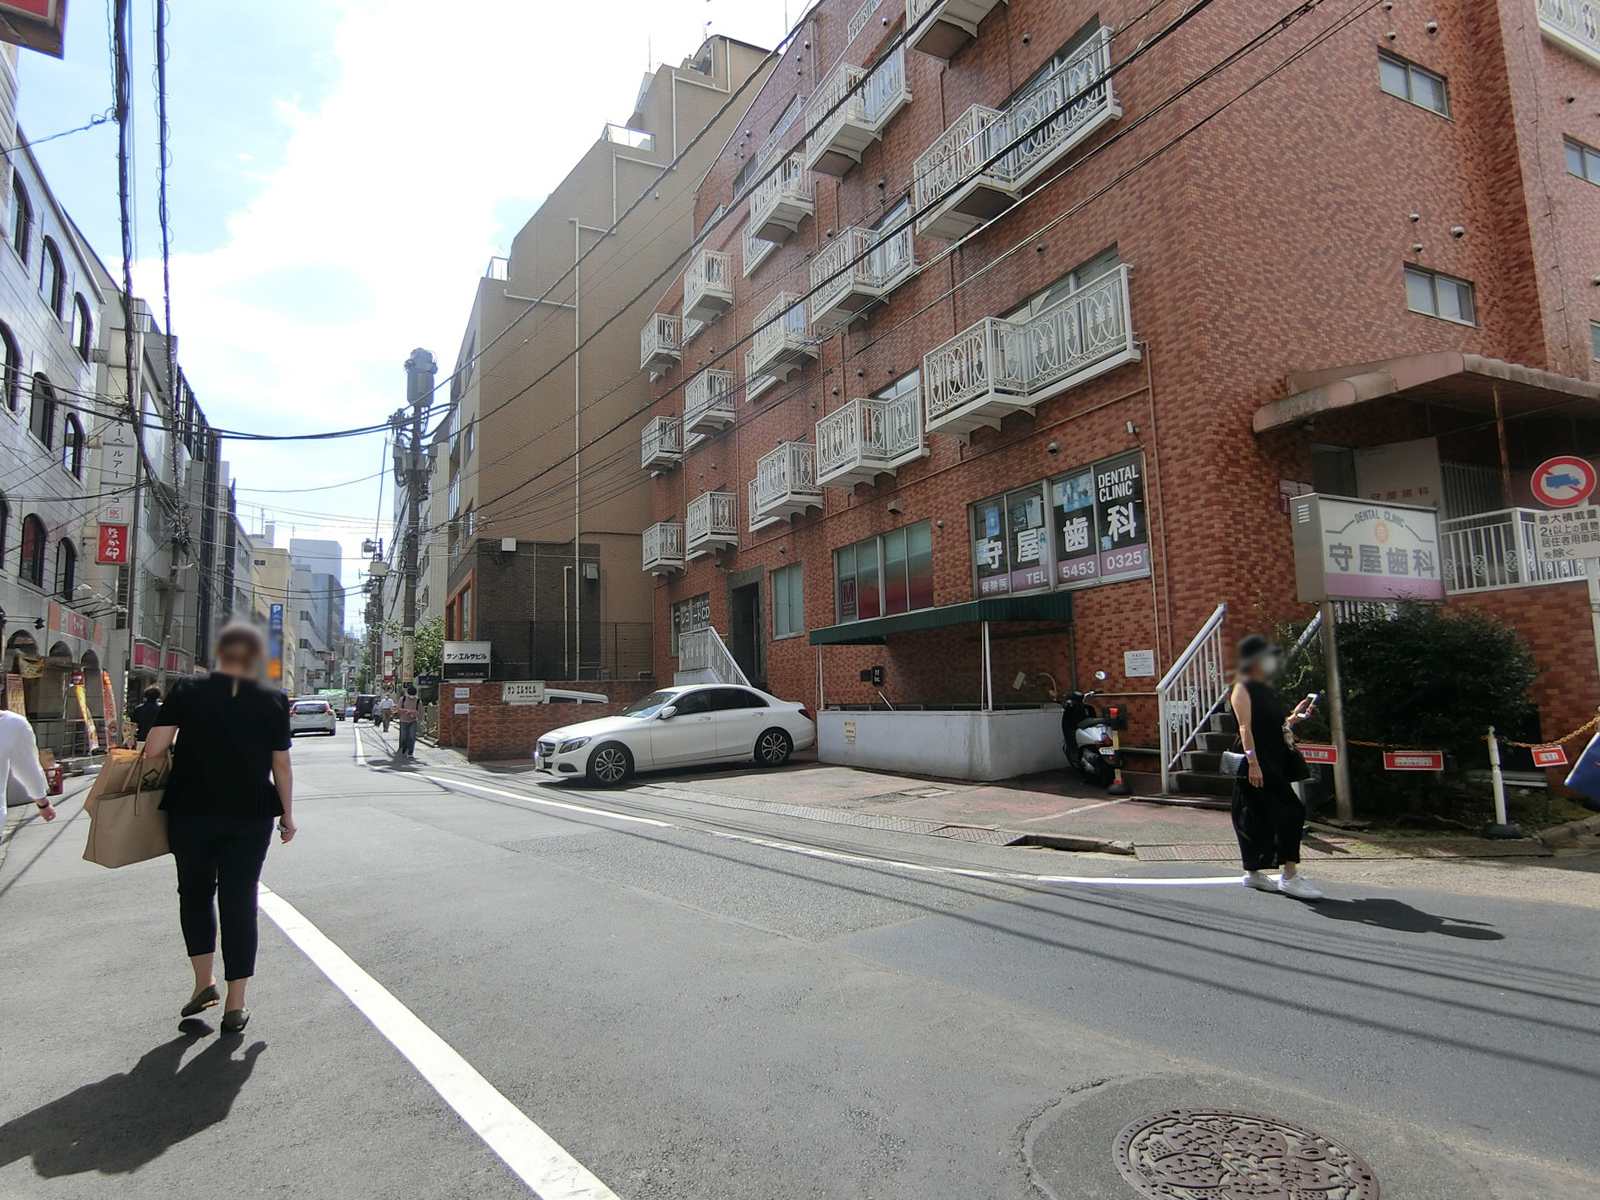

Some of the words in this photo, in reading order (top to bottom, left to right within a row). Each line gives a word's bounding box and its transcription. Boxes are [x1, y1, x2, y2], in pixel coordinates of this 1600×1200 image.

[1098, 465, 1139, 488] DENTAL
[1099, 481, 1133, 503] CLINIC
[1354, 509, 1380, 524] DENTAL
[1384, 510, 1405, 528] CLINIC
[1539, 509, 1597, 525] 最大積載量
[982, 502, 1137, 569] 守屋歯科
[1540, 521, 1600, 536] 2t以上の貨物
[105, 527, 120, 560] なか卯
[1544, 548, 1574, 559] を除く
[1026, 571, 1048, 585] TEL
[1063, 561, 1095, 578] 5453
[1106, 551, 1143, 570] 0325
[1329, 543, 1435, 578] 守屋歯科
[982, 578, 1008, 594] 保険医
[272, 604, 282, 613] P
